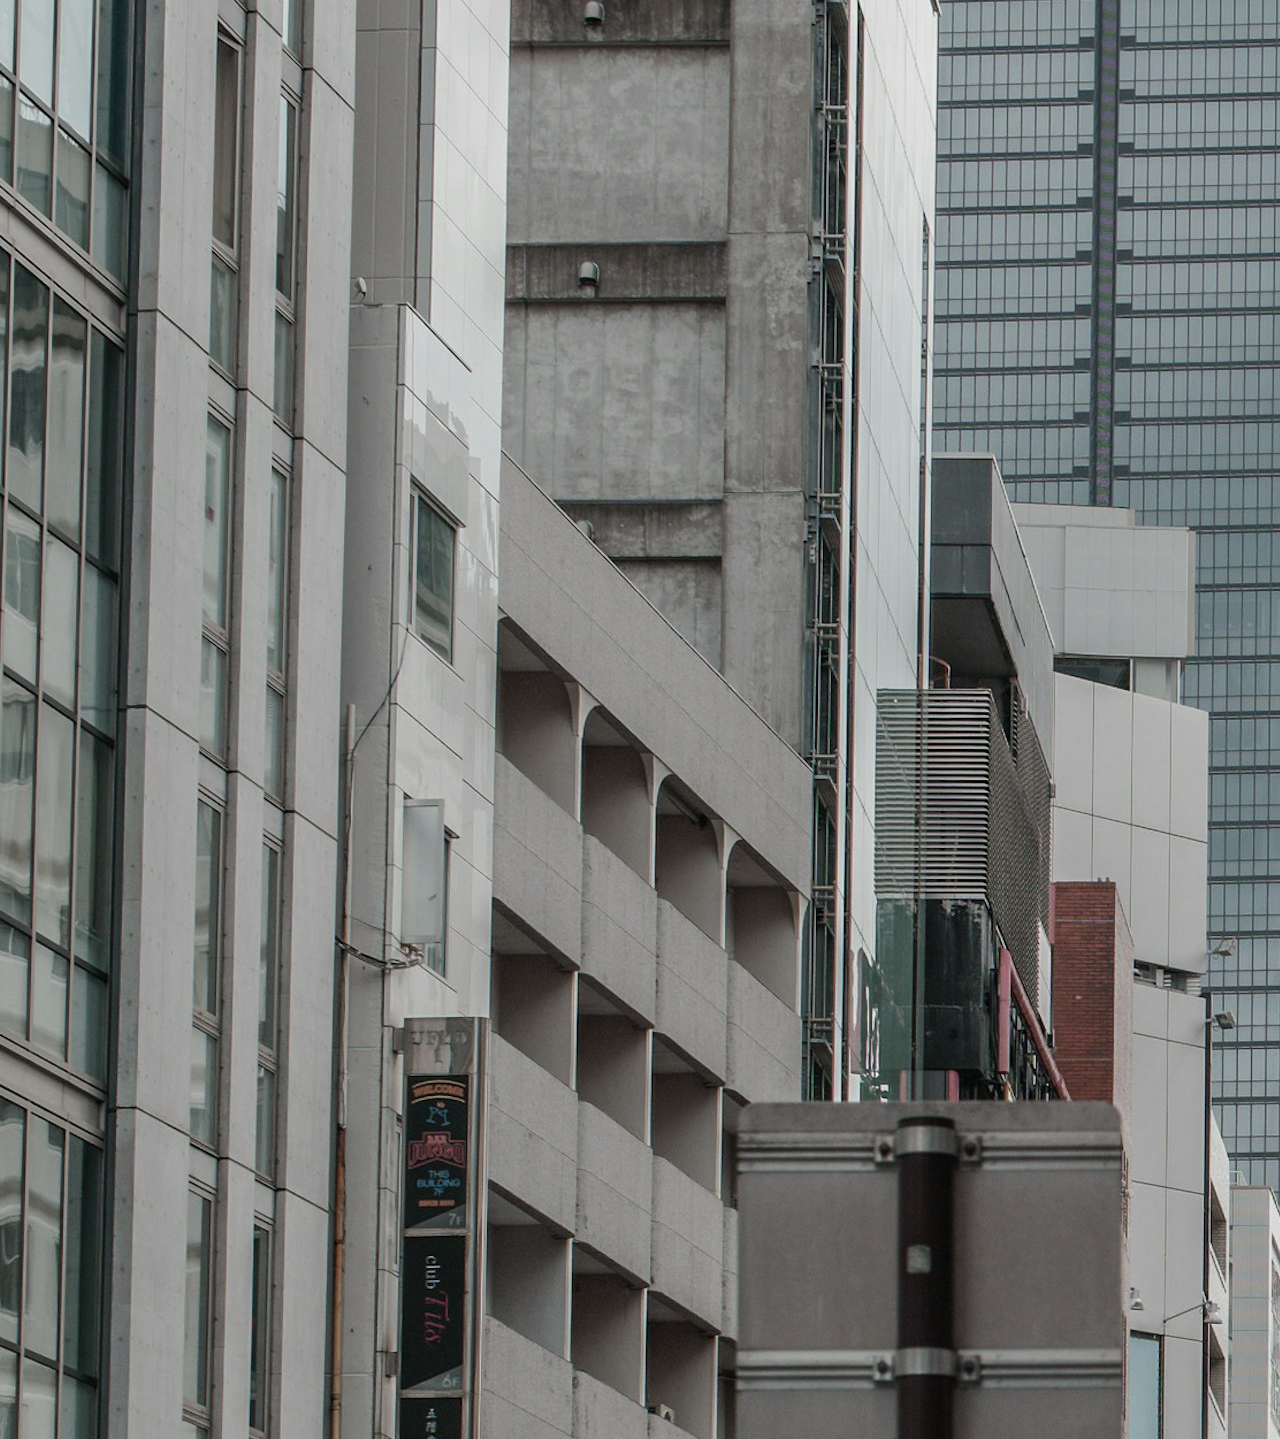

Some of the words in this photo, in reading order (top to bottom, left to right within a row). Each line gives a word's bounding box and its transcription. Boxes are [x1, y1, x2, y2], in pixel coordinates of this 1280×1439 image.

[428, 1169, 450, 1179] THIS
[416, 1178, 461, 1188] BUILDING
[449, 1213, 464, 1227] 7F
[425, 1255, 441, 1290] club
[442, 1375, 461, 1388] 6F
